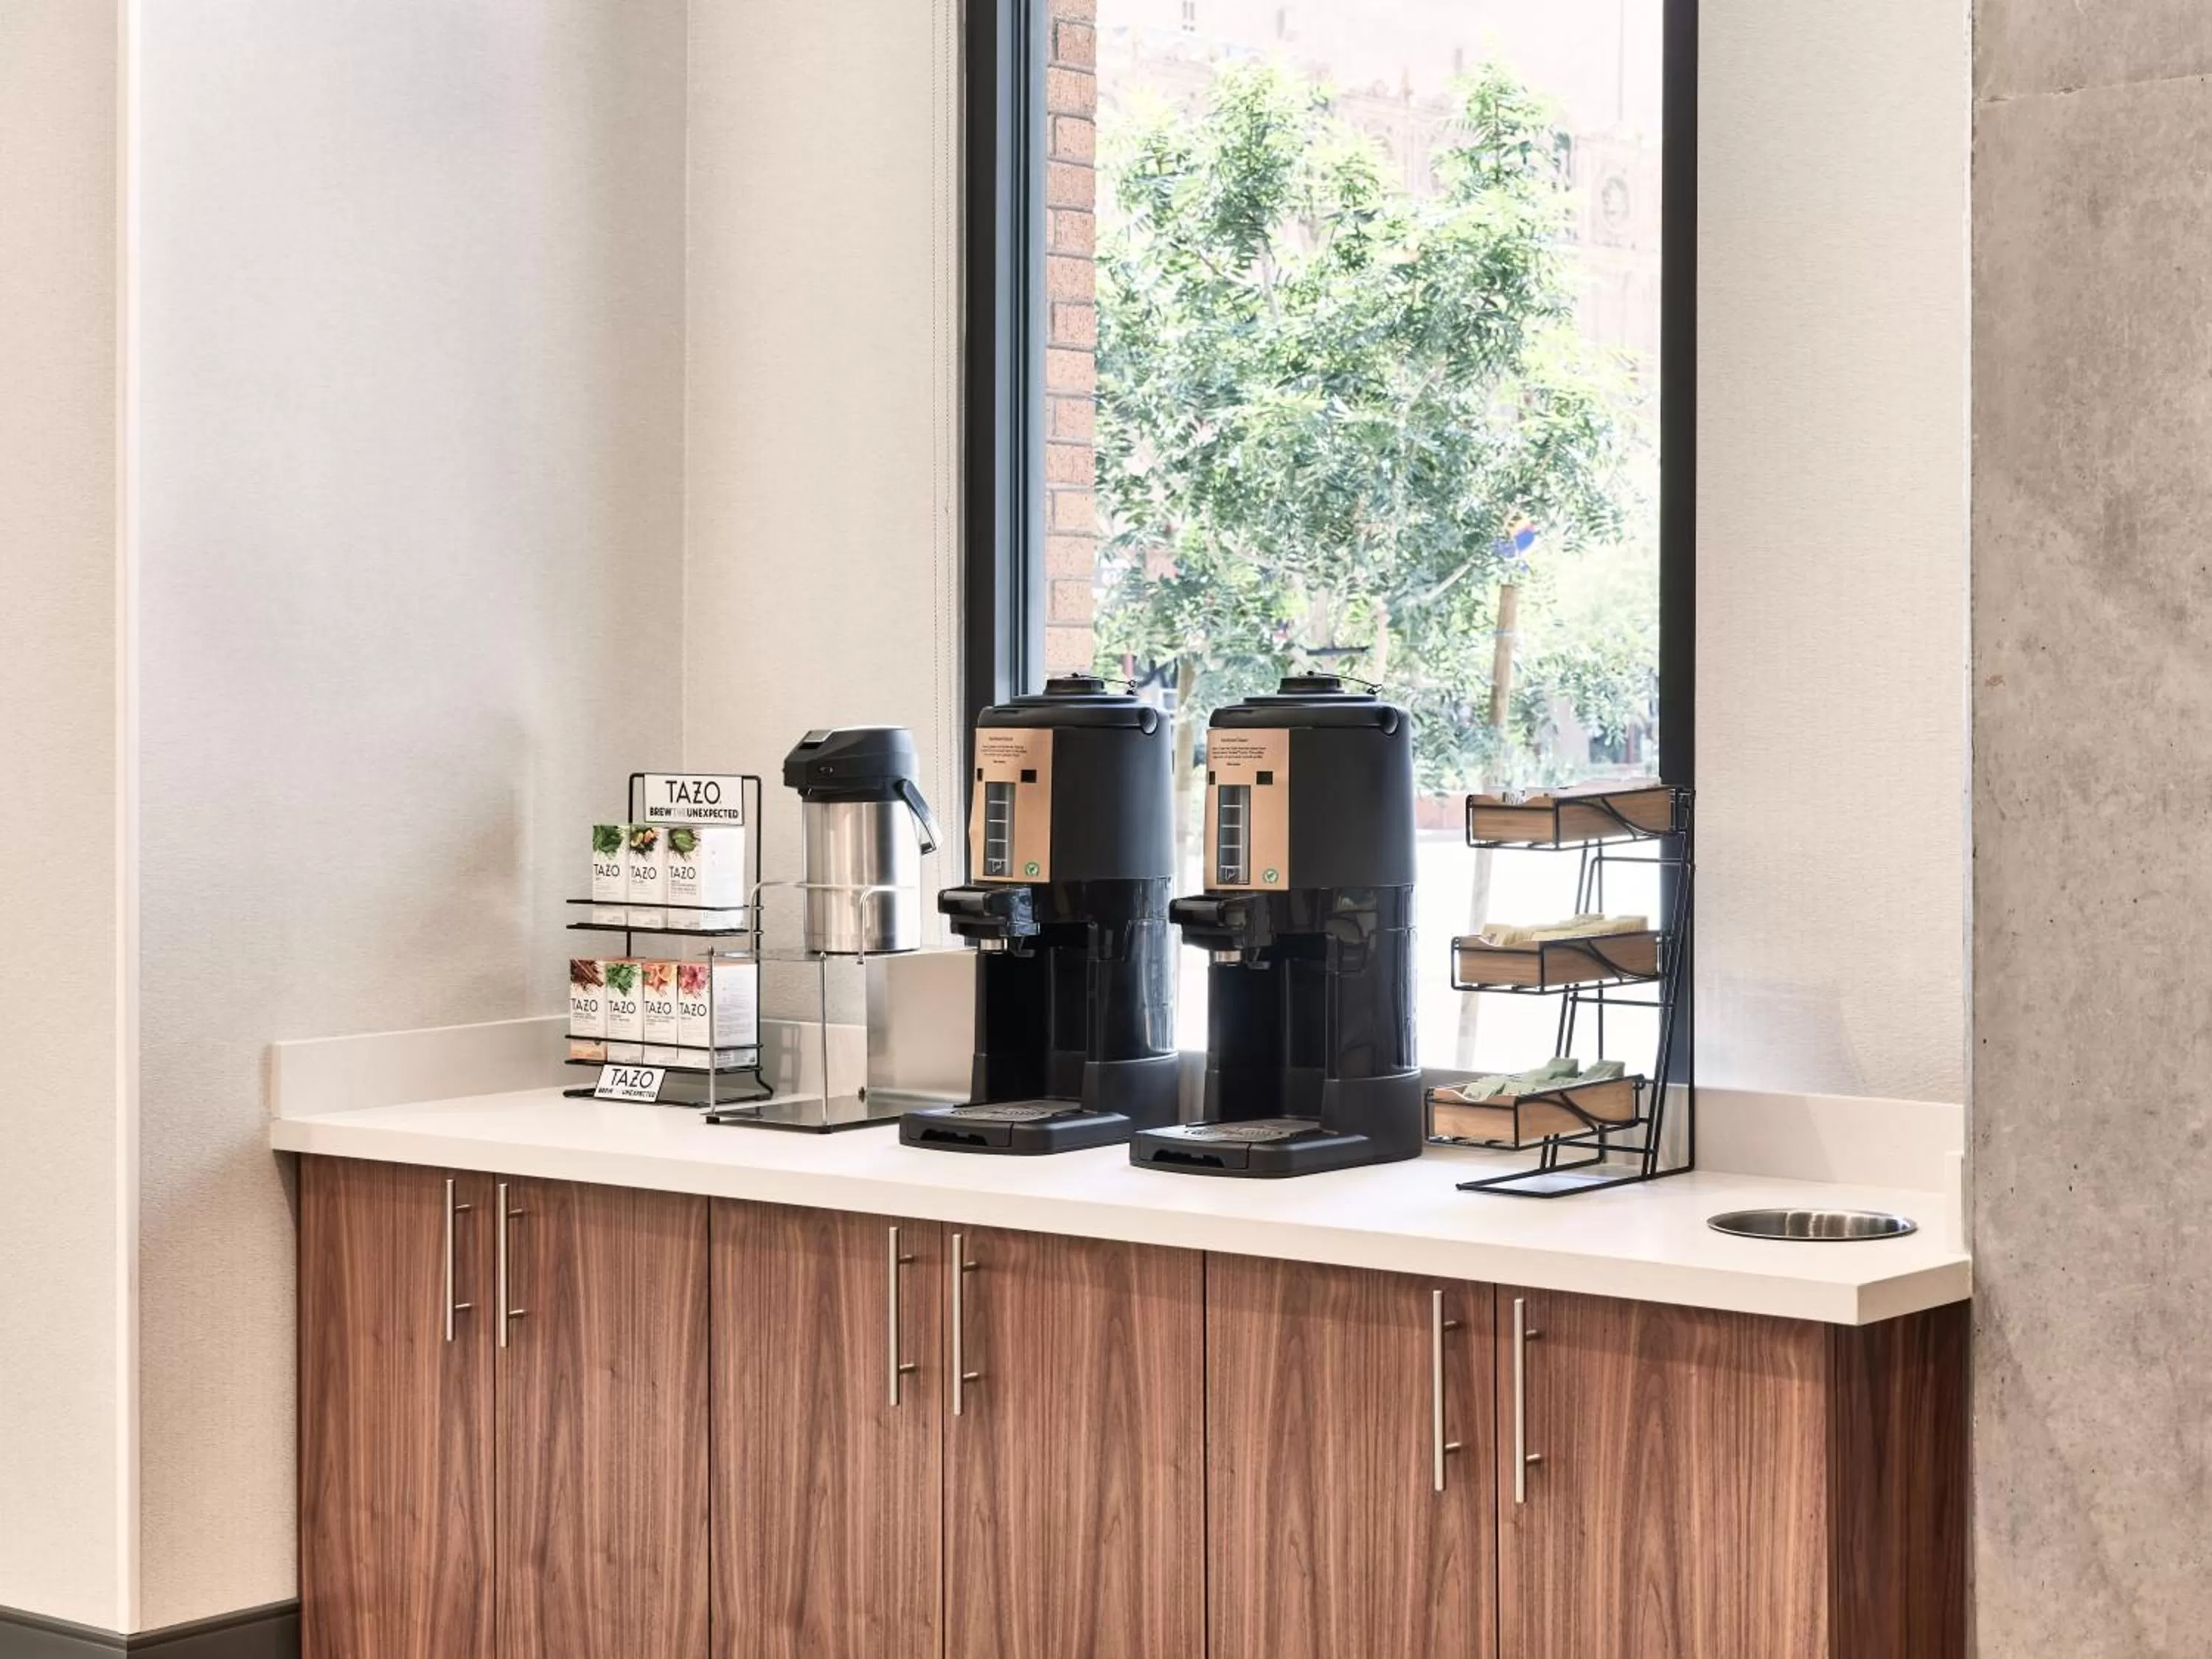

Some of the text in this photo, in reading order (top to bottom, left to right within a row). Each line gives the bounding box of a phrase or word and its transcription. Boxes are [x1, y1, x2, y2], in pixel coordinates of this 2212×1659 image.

[665, 780, 720, 804] TAZO
[650, 807, 672, 816] BREW
[686, 808, 739, 818] UNEXPECTED
[593, 863, 620, 877] TAZO
[630, 866, 657, 880] TAZO
[669, 866, 697, 880] TAZO
[571, 998, 598, 1012] TAZO
[608, 1000, 636, 1015] TAZO
[644, 1001, 672, 1015] TAZO
[679, 1002, 707, 1017] TAZO
[611, 1068, 654, 1088] TAZO
